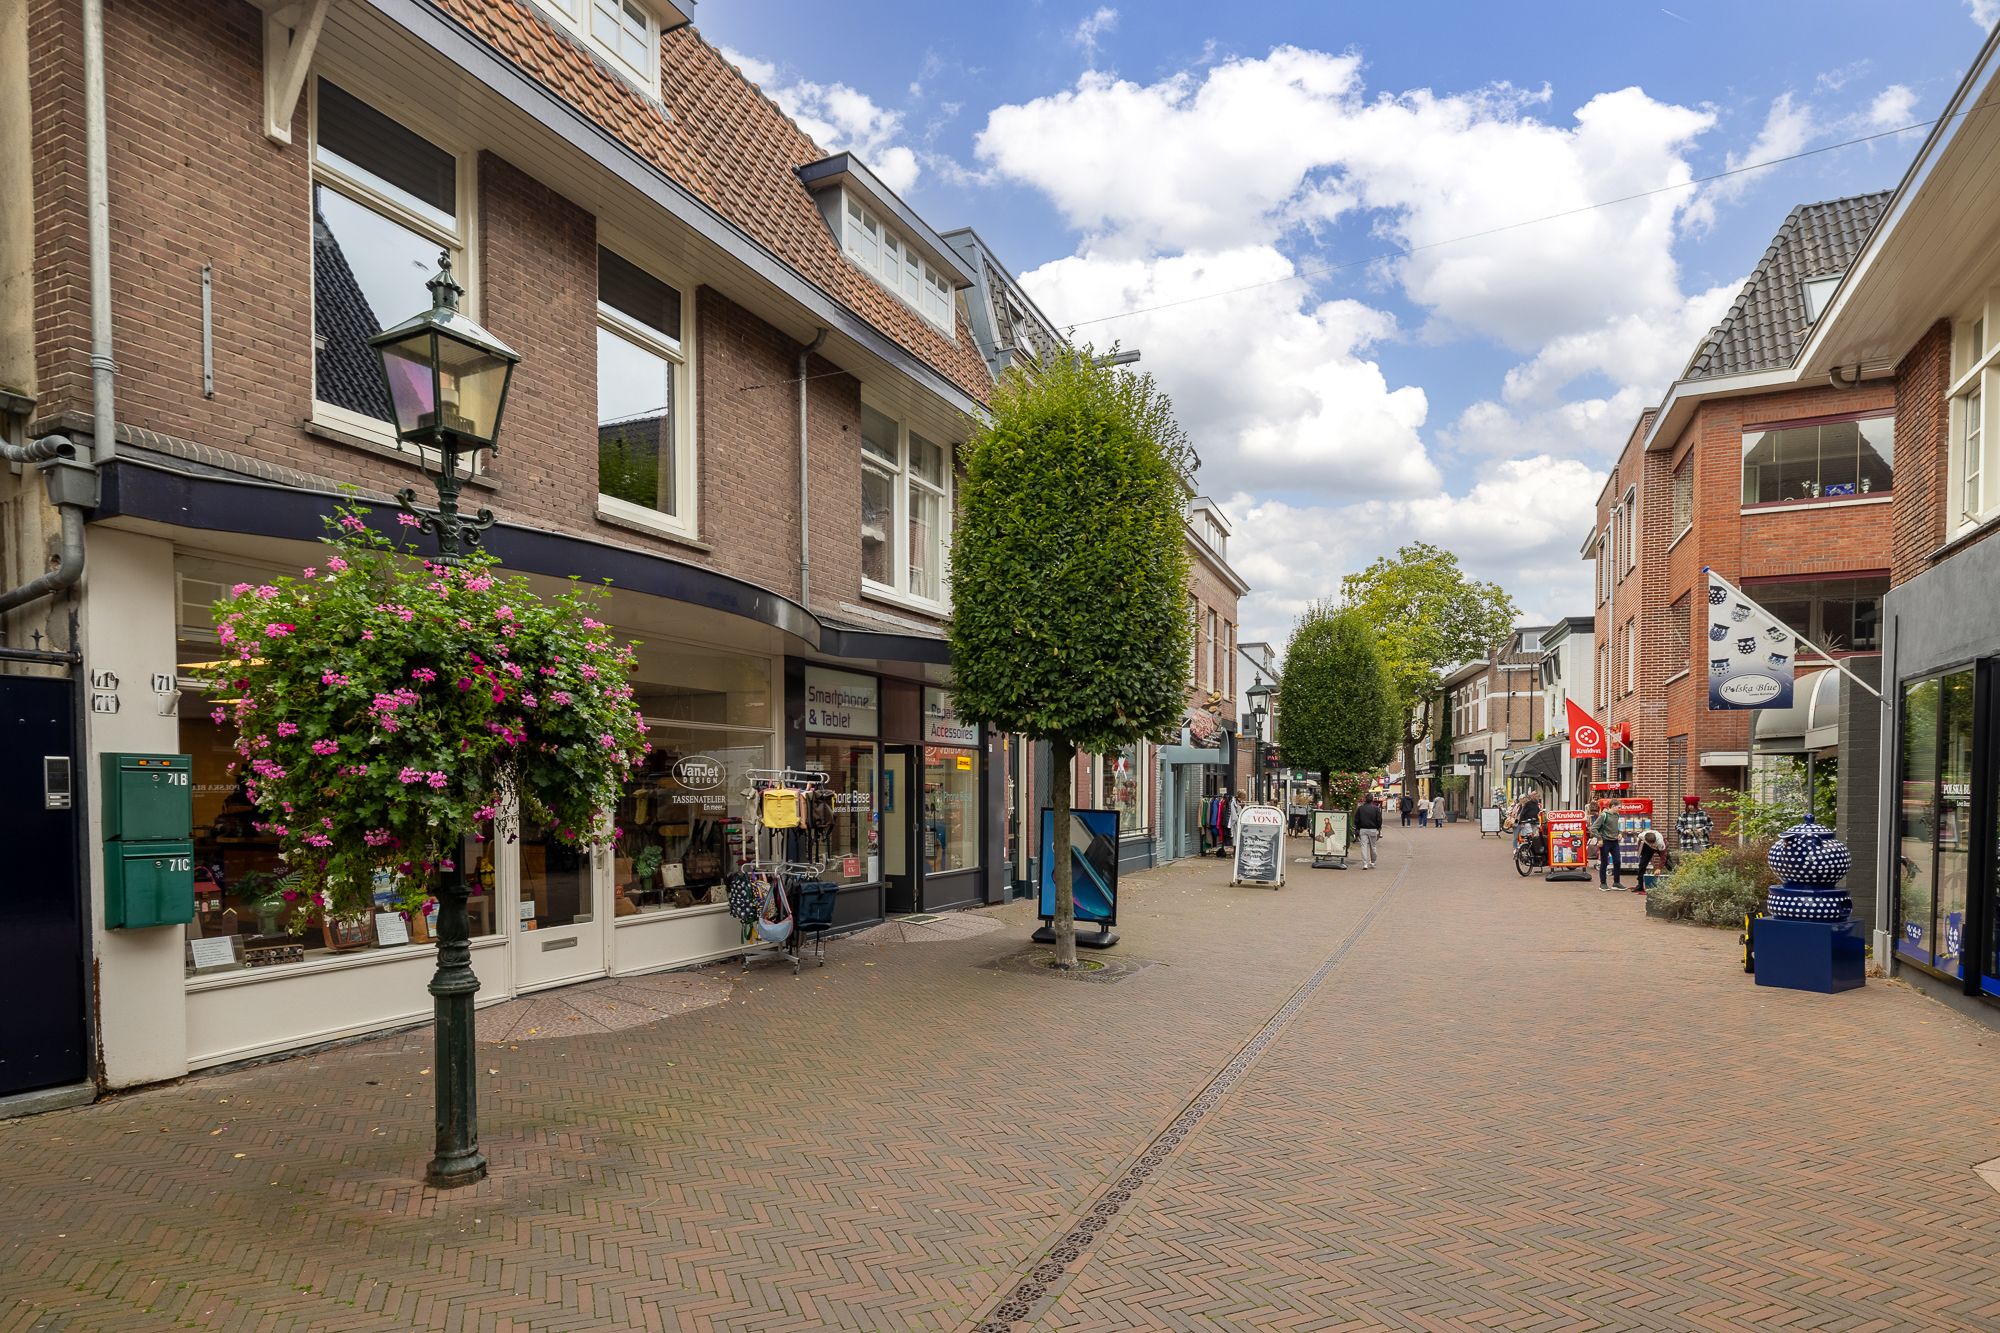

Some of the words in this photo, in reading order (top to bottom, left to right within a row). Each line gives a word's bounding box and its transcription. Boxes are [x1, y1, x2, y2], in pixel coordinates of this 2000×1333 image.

[157, 675, 170, 690] 71
[1723, 683, 1754, 693] Polska
[1756, 682, 1777, 691] Blue
[808, 686, 868, 708] Smartphone
[808, 709, 817, 725] &
[821, 710, 850, 728] Tablet
[931, 723, 973, 739] Accessoires
[680, 764, 719, 777] VanJet
[168, 773, 188, 785] 71B
[1943, 784, 1962, 794] POLSKA
[672, 796, 726, 804] TASSENATELIER
[852, 790, 870, 803] Base
[1253, 815, 1278, 823] VONK
[1552, 822, 1582, 830] ACTIE!
[169, 858, 190, 871] 71C
